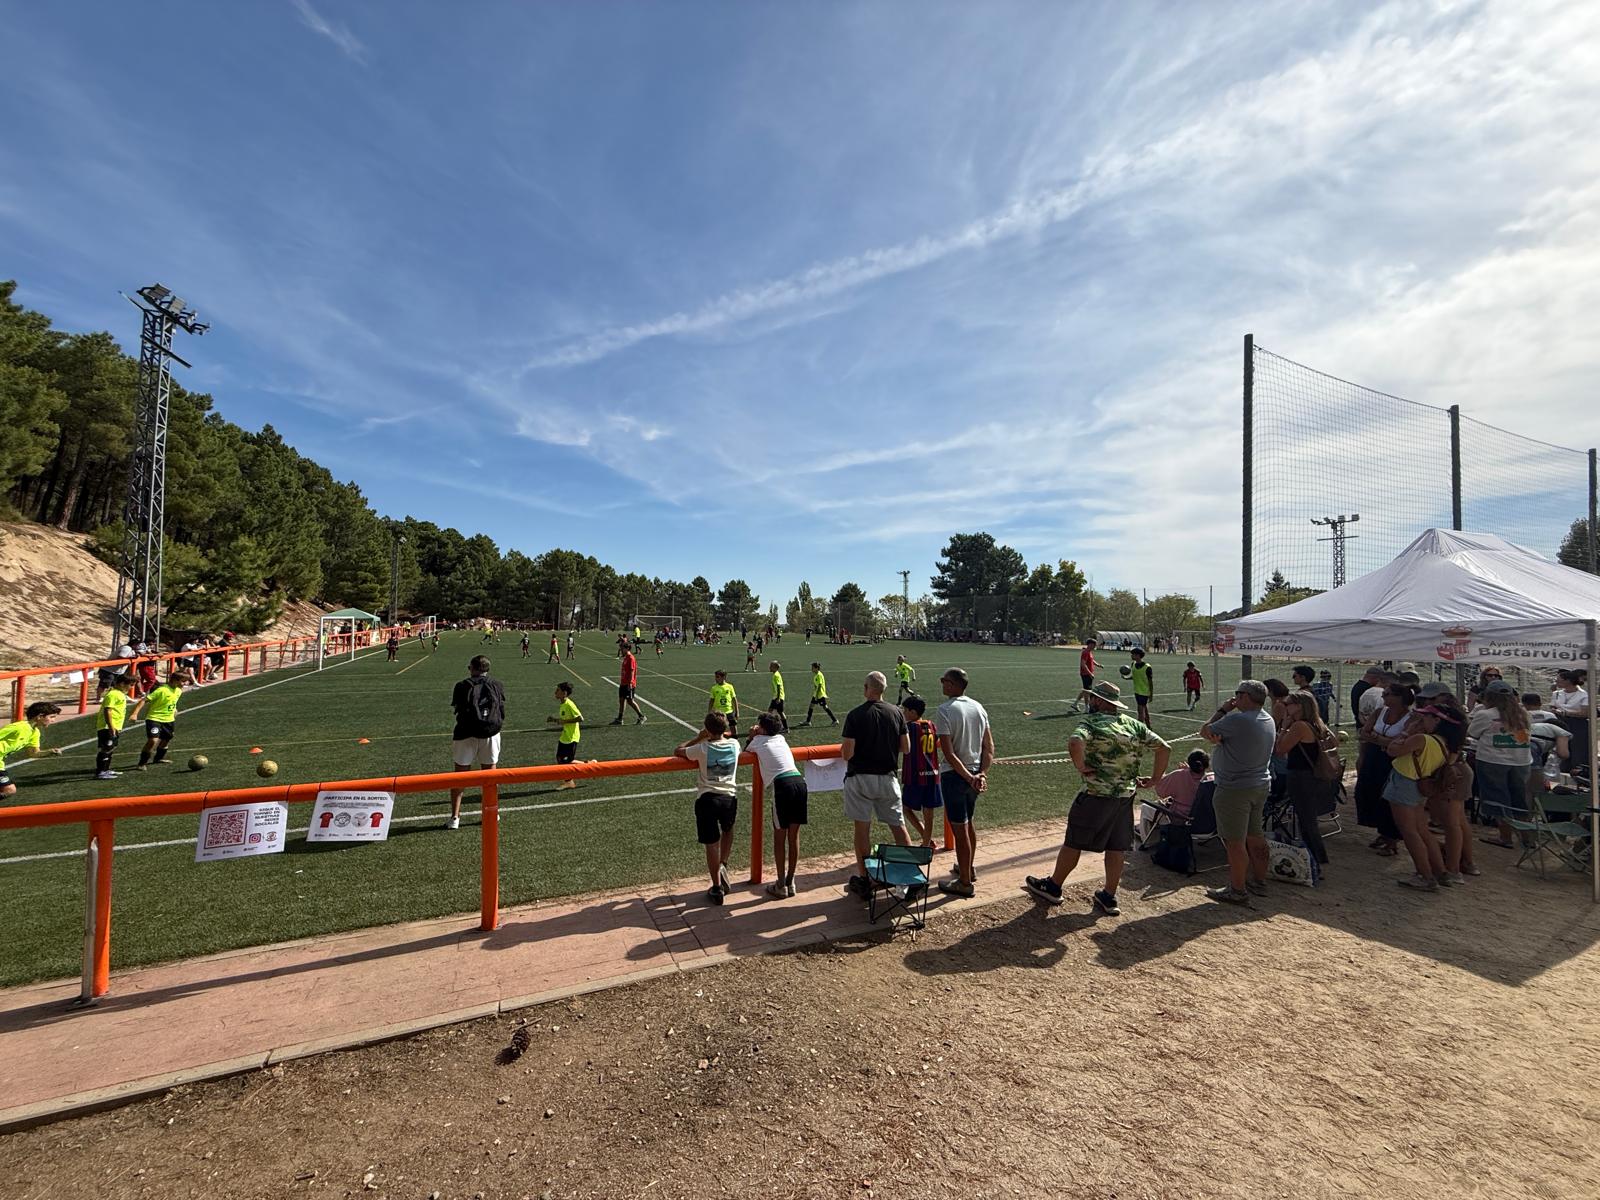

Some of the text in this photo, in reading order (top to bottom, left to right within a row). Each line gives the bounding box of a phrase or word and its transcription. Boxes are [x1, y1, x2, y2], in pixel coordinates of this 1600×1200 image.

[1239, 643, 1303, 653] Bustarviejo
[1479, 647, 1591, 661] Bustarviejo
[921, 733, 934, 753] 10
